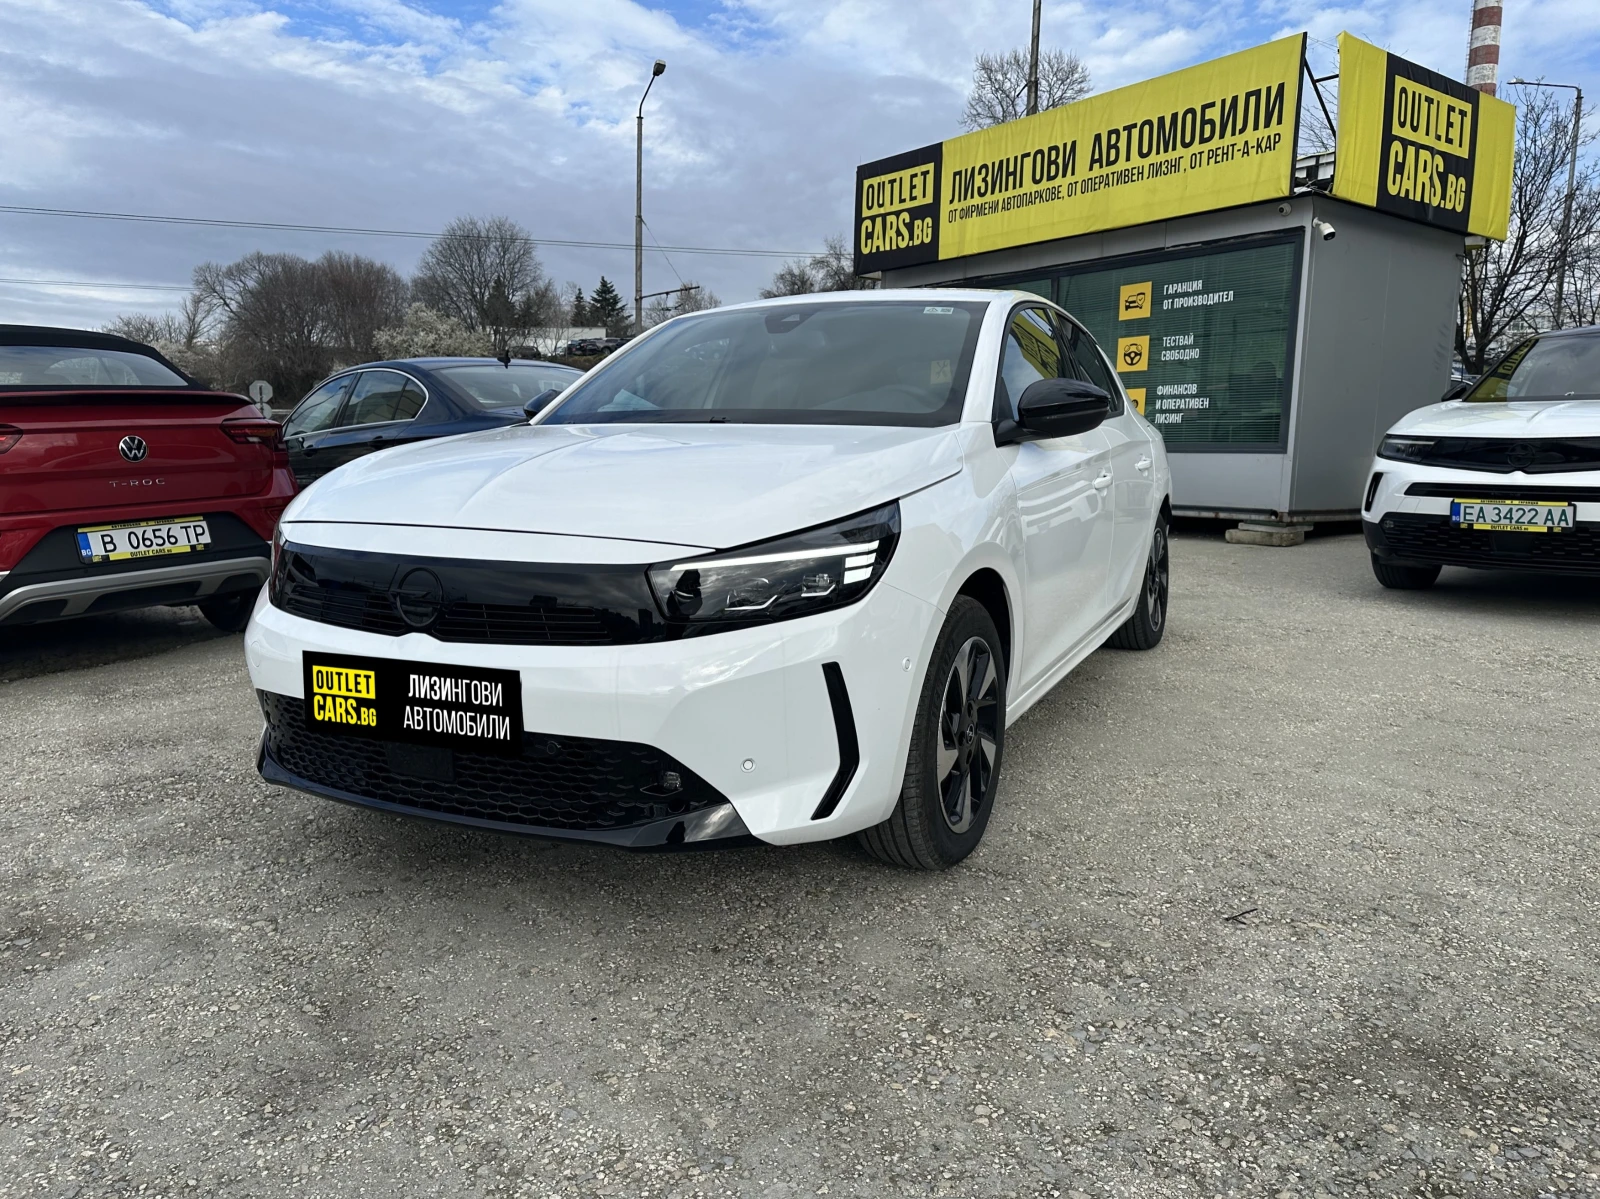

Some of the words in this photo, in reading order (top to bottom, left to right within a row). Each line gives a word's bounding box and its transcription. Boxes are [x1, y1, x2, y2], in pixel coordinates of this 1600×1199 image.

[1397, 86, 1468, 149] OUTLET
[949, 139, 1077, 205] ЛИЗИНГОВИ
[1088, 81, 1285, 172] АВТОМОБИЛИ
[948, 208, 959, 224] ОТ
[959, 199, 999, 221] ФИРМЕНИ
[1000, 184, 1065, 213] АВТОПАРКОВЕ,
[1067, 181, 1079, 198] ОТ
[1080, 165, 1144, 195] ОПЕРАТИВЕН
[1189, 150, 1205, 170] ОТ
[1206, 132, 1282, 166] РЕНТ-А-КАР
[1386, 140, 1467, 213] CARS.BG
[866, 169, 930, 211] OUTLET
[860, 211, 933, 255] CARS.BG
[1163, 279, 1203, 295] ГАРАНЦИЯ
[1162, 299, 1173, 310] ОТ
[1173, 290, 1234, 309] ПРОИЗВОДИТЕЛ
[1162, 332, 1194, 347] ТЕСТВАЙ
[1161, 348, 1200, 361] СВОБОДНО
[1156, 383, 1198, 396] ФИНАНСОВ
[1162, 397, 1210, 410] ОПЕРАТИВЕН
[1154, 412, 1185, 424] ЛИЗИНГ
[109, 478, 165, 488] T-ROC
[1463, 505, 1487, 523] EA
[1490, 506, 1539, 525] 3422
[1543, 508, 1569, 526] AA
[100, 533, 117, 553] B
[127, 526, 178, 550] 0656
[180, 524, 206, 544] TP
[81, 548, 92, 556] BG
[130, 549, 150, 558] OUTLET
